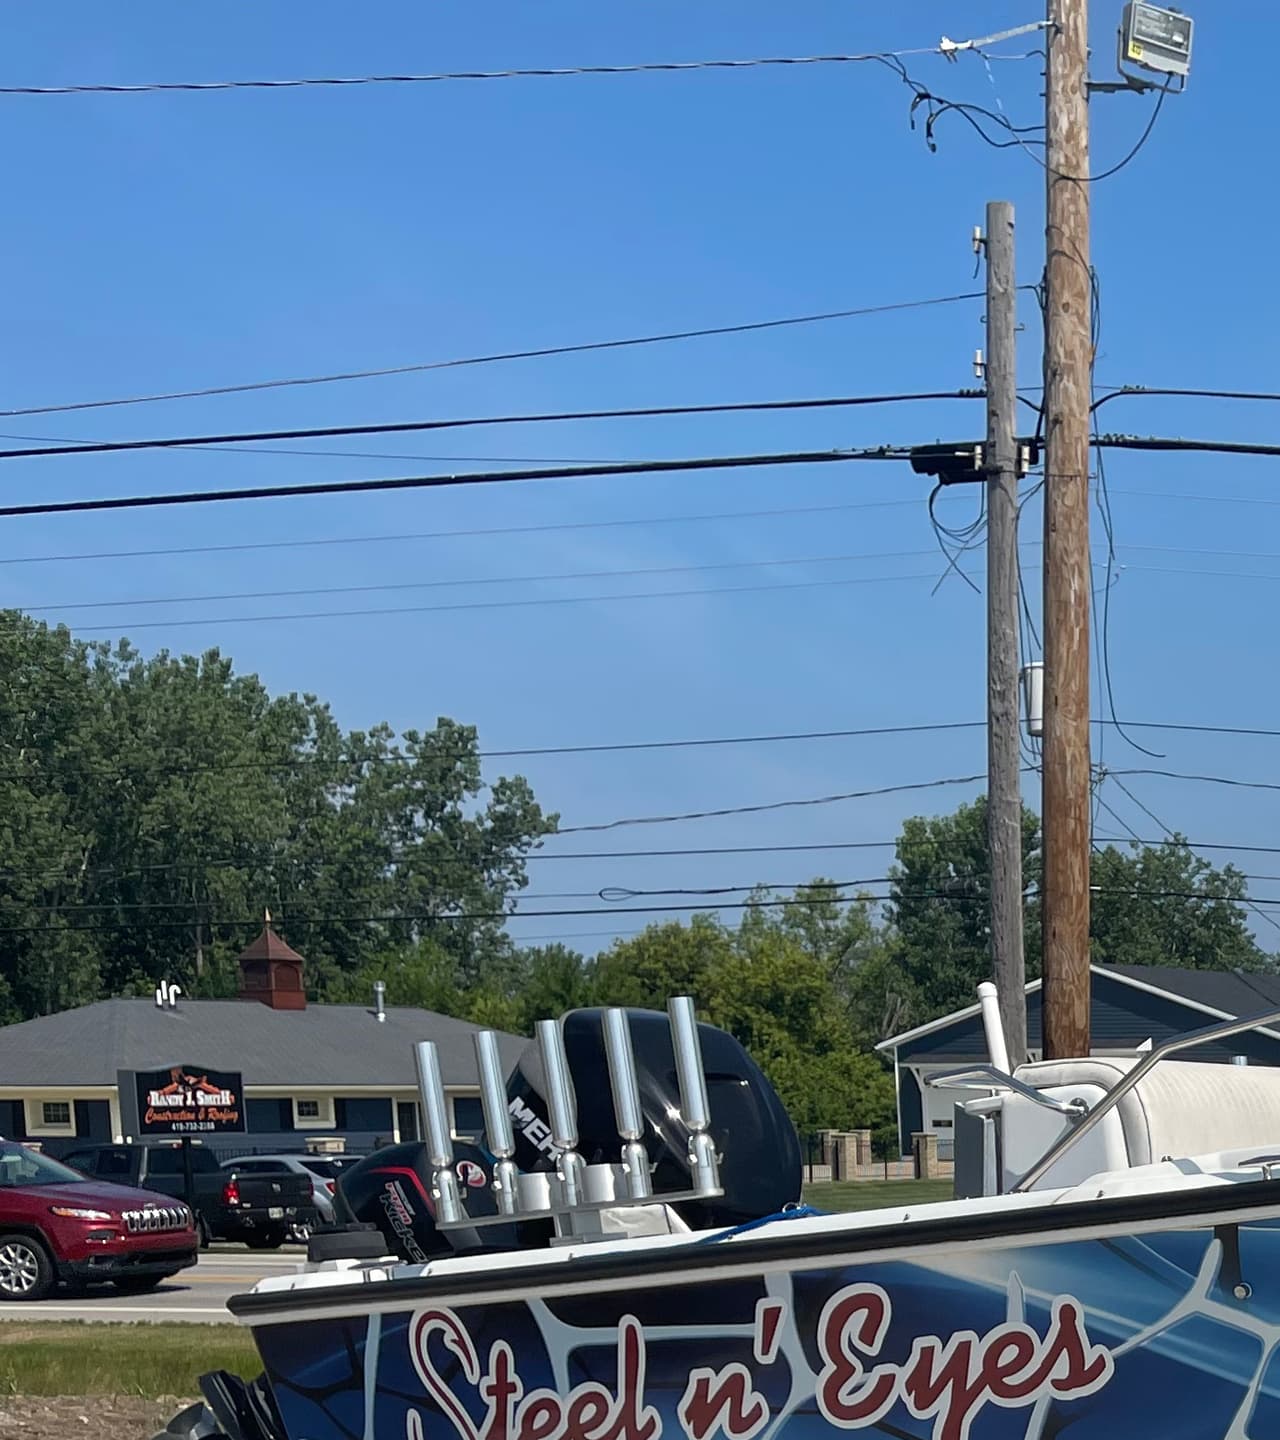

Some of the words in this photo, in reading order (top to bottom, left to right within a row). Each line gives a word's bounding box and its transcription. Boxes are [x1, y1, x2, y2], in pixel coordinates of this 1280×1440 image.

[149, 1090, 184, 1106] RANDY
[186, 1090, 196, 1106] J.
[196, 1090, 231, 1106] SMITH
[144, 1107, 195, 1124] Construction
